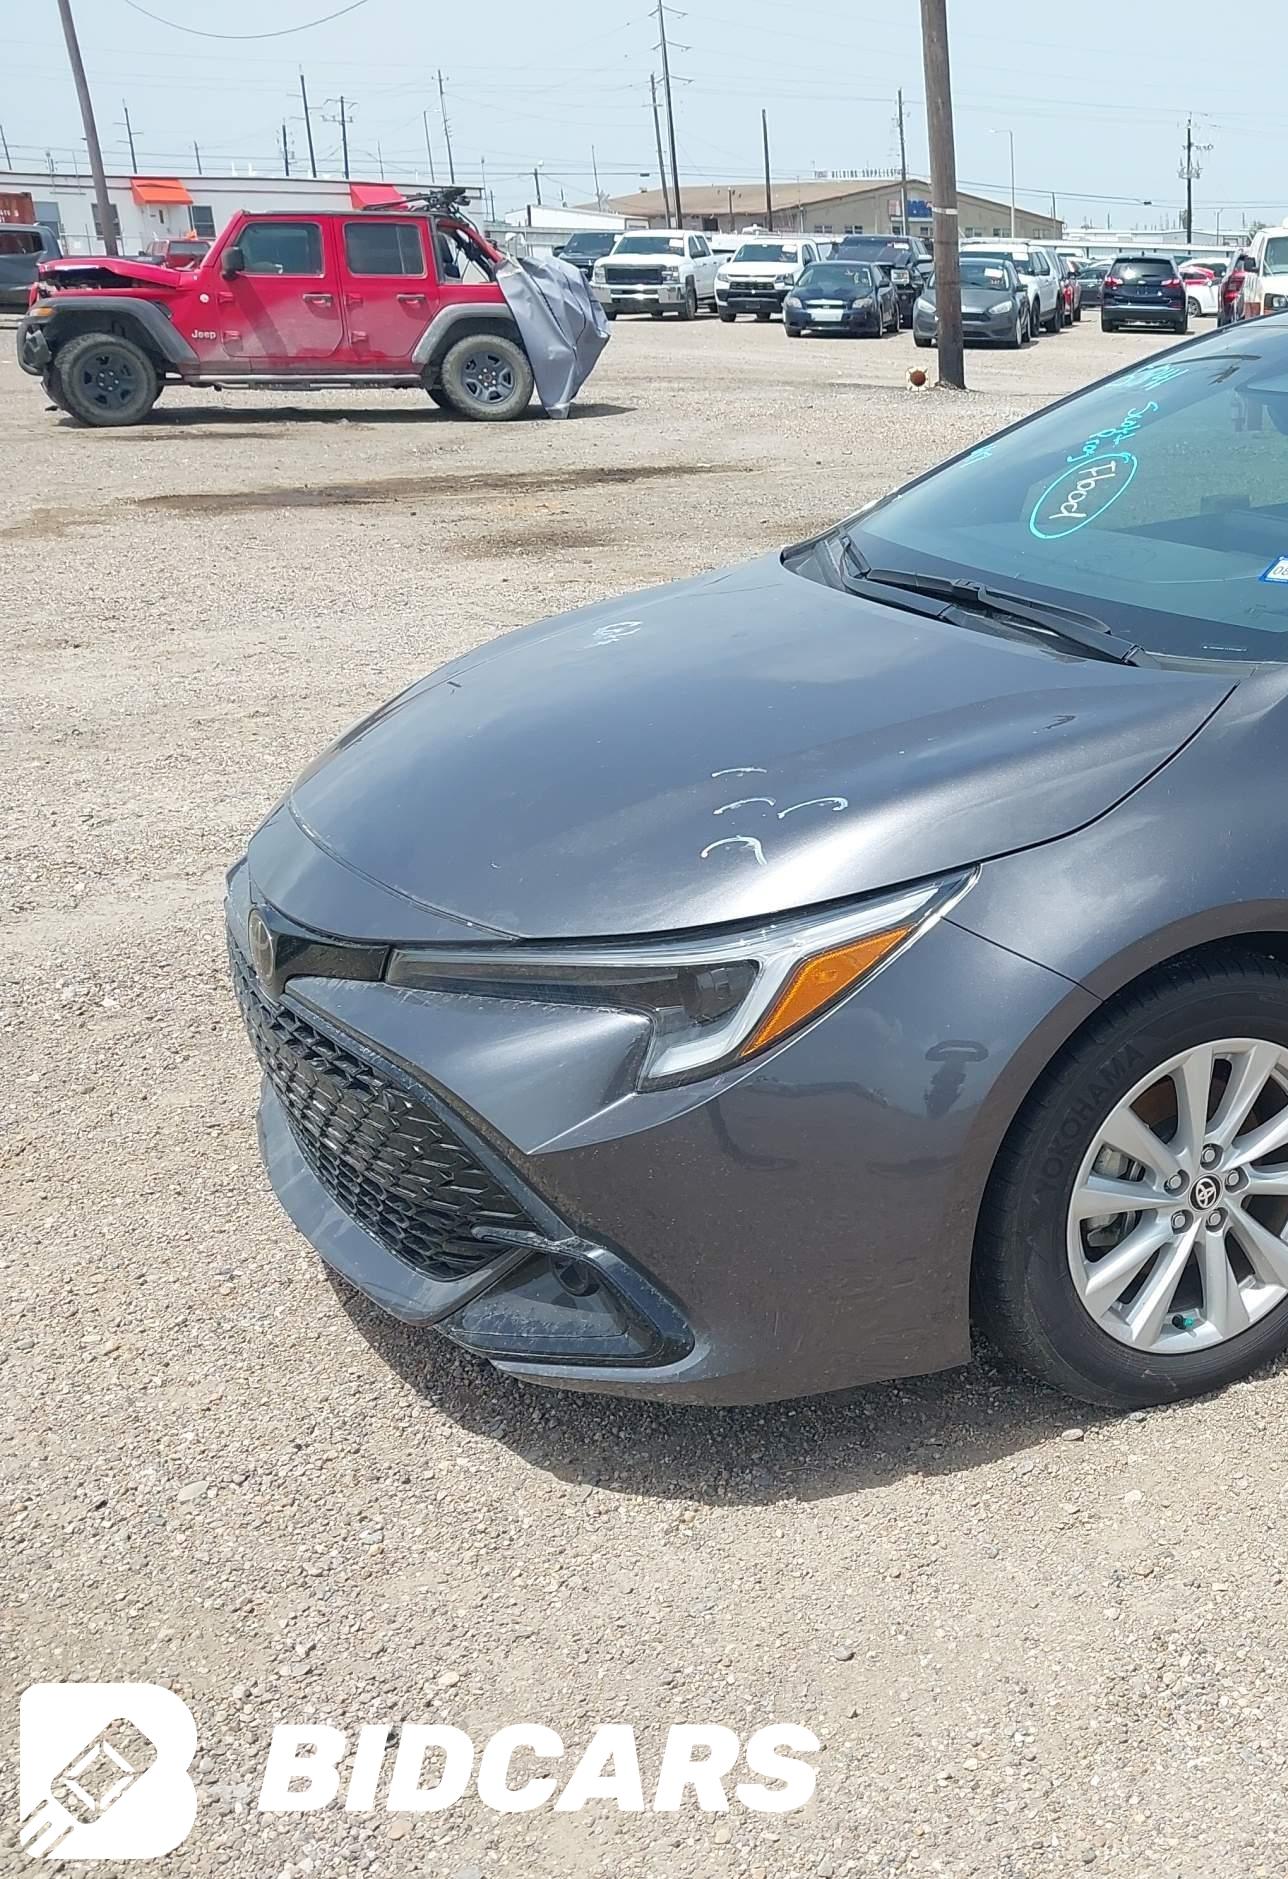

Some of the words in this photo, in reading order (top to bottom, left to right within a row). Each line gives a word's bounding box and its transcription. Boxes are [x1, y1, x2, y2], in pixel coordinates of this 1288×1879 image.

[191, 329, 217, 340] Jeep
[1048, 459, 1117, 520] Flood
[1033, 1042, 1146, 1198] YOKOHAMA
